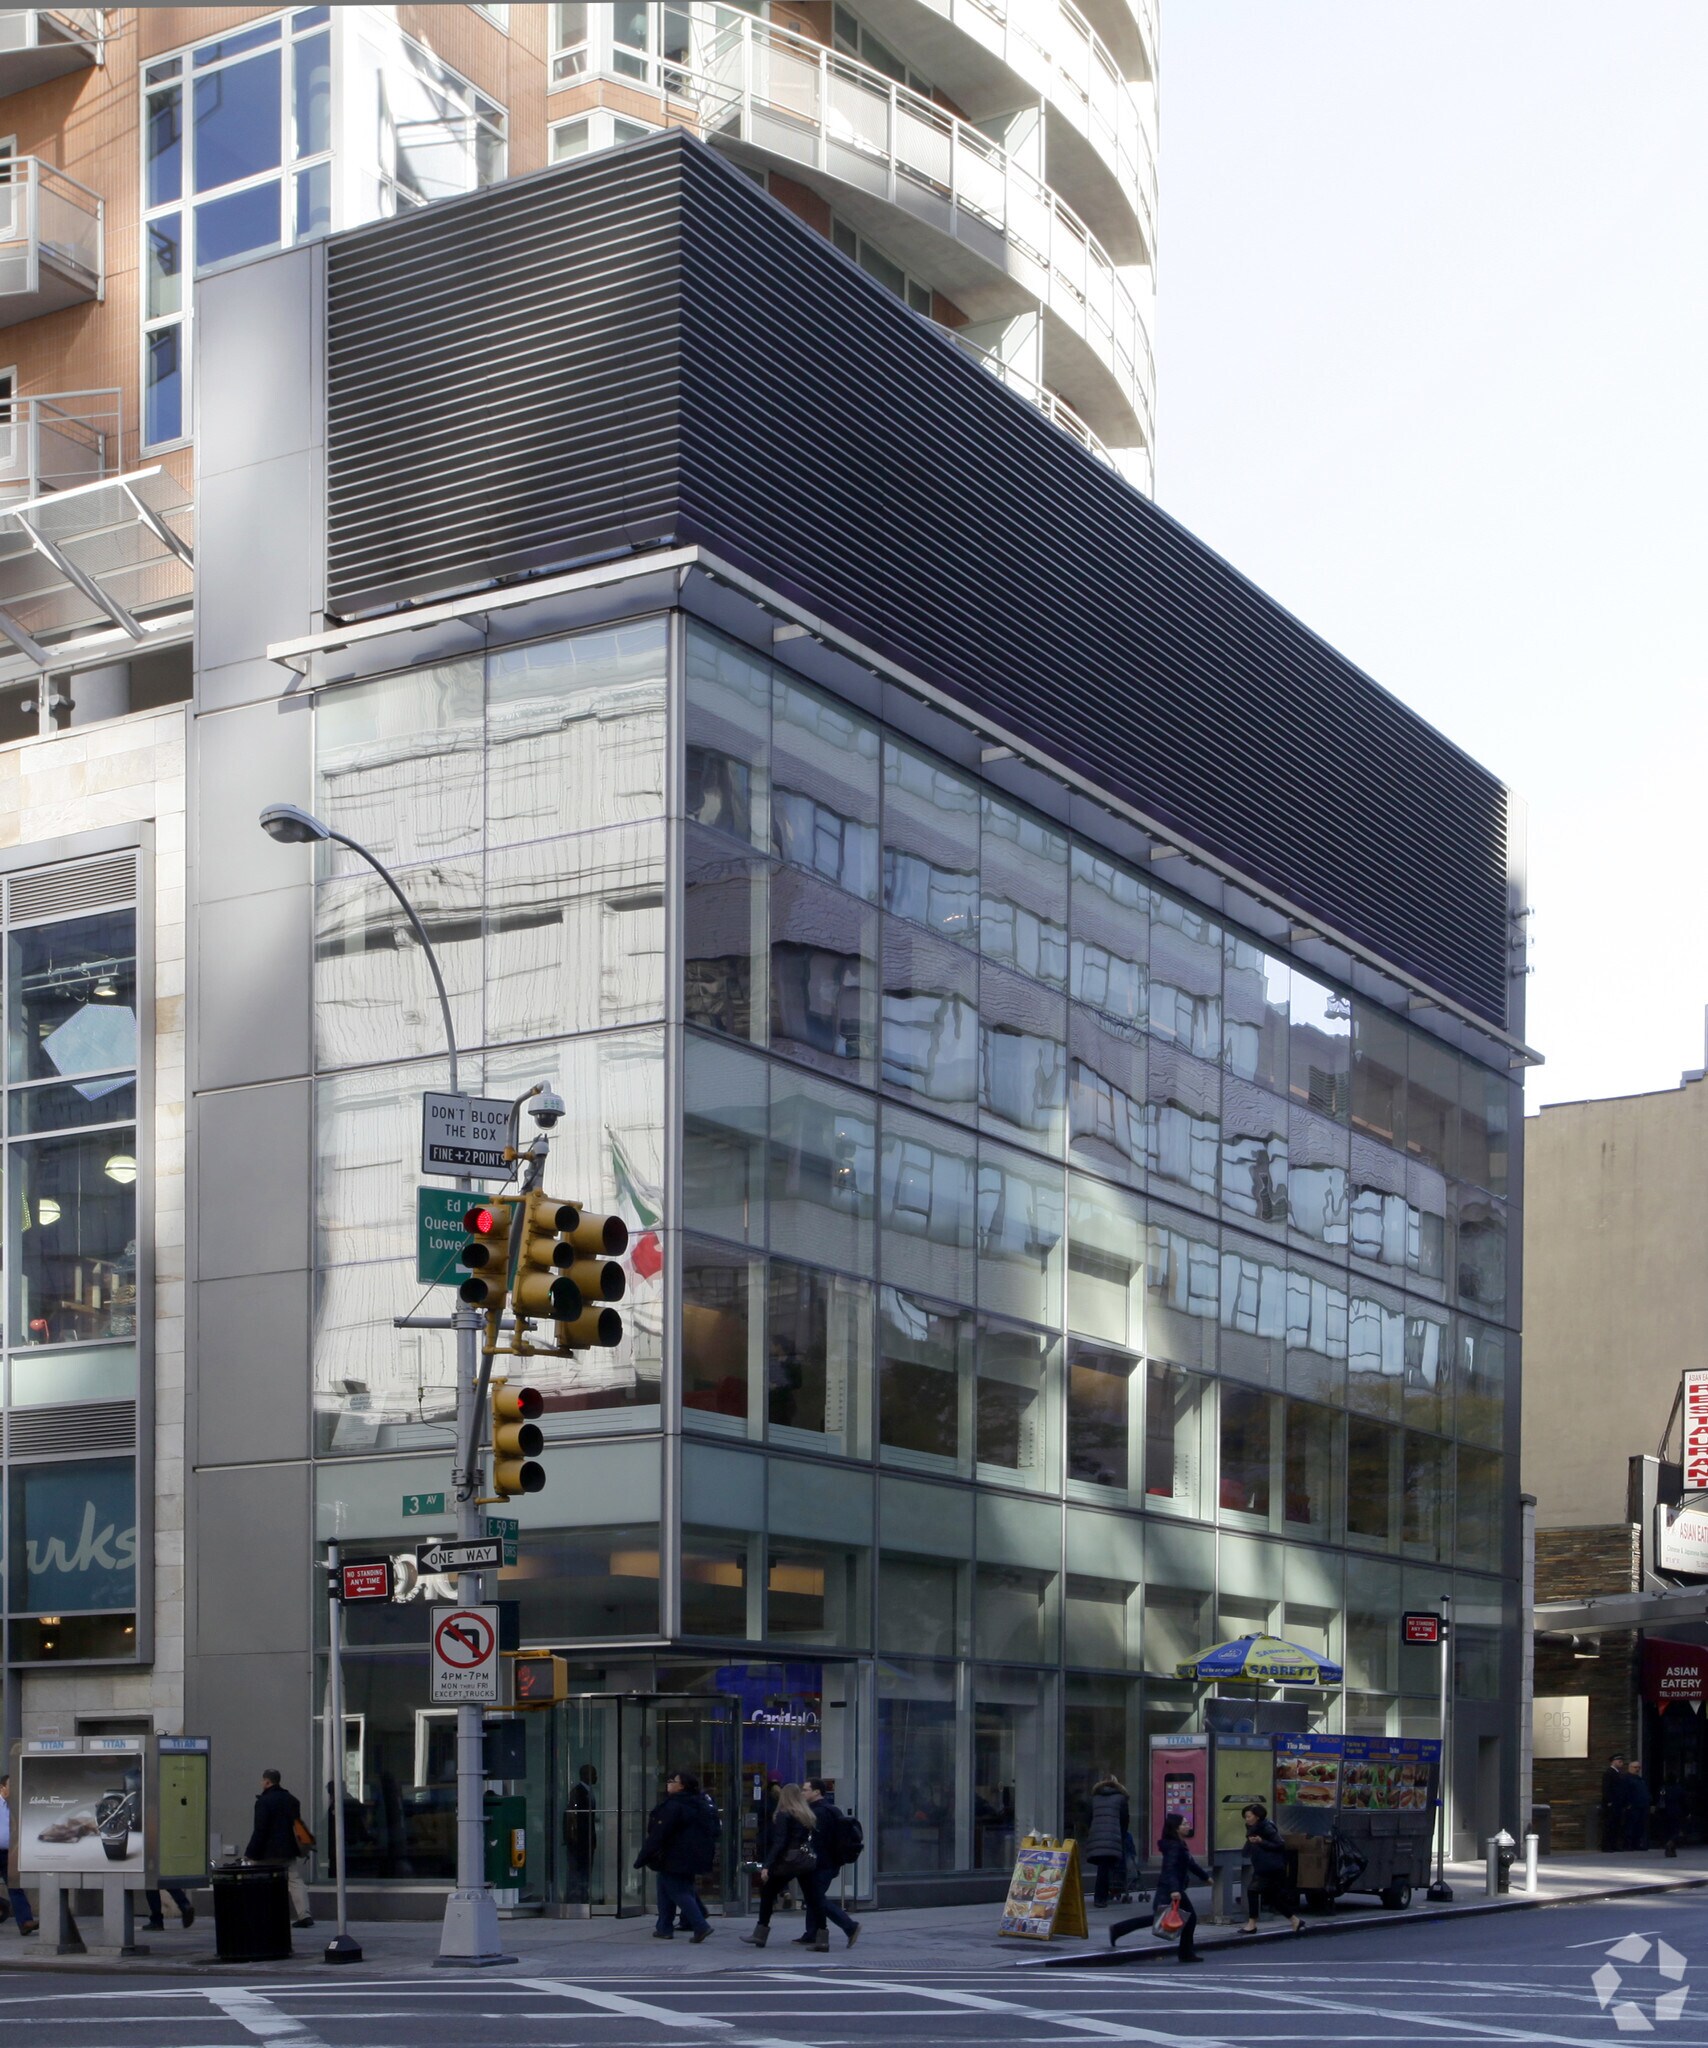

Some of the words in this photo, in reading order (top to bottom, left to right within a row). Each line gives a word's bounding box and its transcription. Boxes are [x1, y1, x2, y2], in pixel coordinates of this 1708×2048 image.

[432, 1105, 465, 1121] DON'T
[471, 1110, 510, 1125] BLOCK
[445, 1123, 466, 1138] THE
[473, 1127, 497, 1141] BOX
[433, 1146, 454, 1161] FINE
[473, 1151, 507, 1166] POINTS
[447, 1199, 461, 1212] Ed
[424, 1216, 467, 1233] Queen
[409, 1496, 420, 1514] 3
[426, 1494, 438, 1505] AV
[488, 1520, 494, 1536] E
[496, 1521, 507, 1538] 59
[509, 1522, 517, 1531] ST
[1680, 1522, 1697, 1541] ASIAN
[430, 1551, 454, 1565] ONE
[466, 1548, 492, 1561] WAY
[357, 1569, 384, 1577] STANDING
[1249, 1664, 1315, 1676] SABRETT
[1666, 1667, 1699, 1676] ASIAN
[1660, 1679, 1702, 1688] EATERY
[1543, 1711, 1571, 1727] 205
[41, 1741, 64, 1749] TITAN
[102, 1739, 126, 1748] TITAN
[171, 1739, 196, 1748] TITAN
[1166, 1736, 1193, 1744] TITAN
